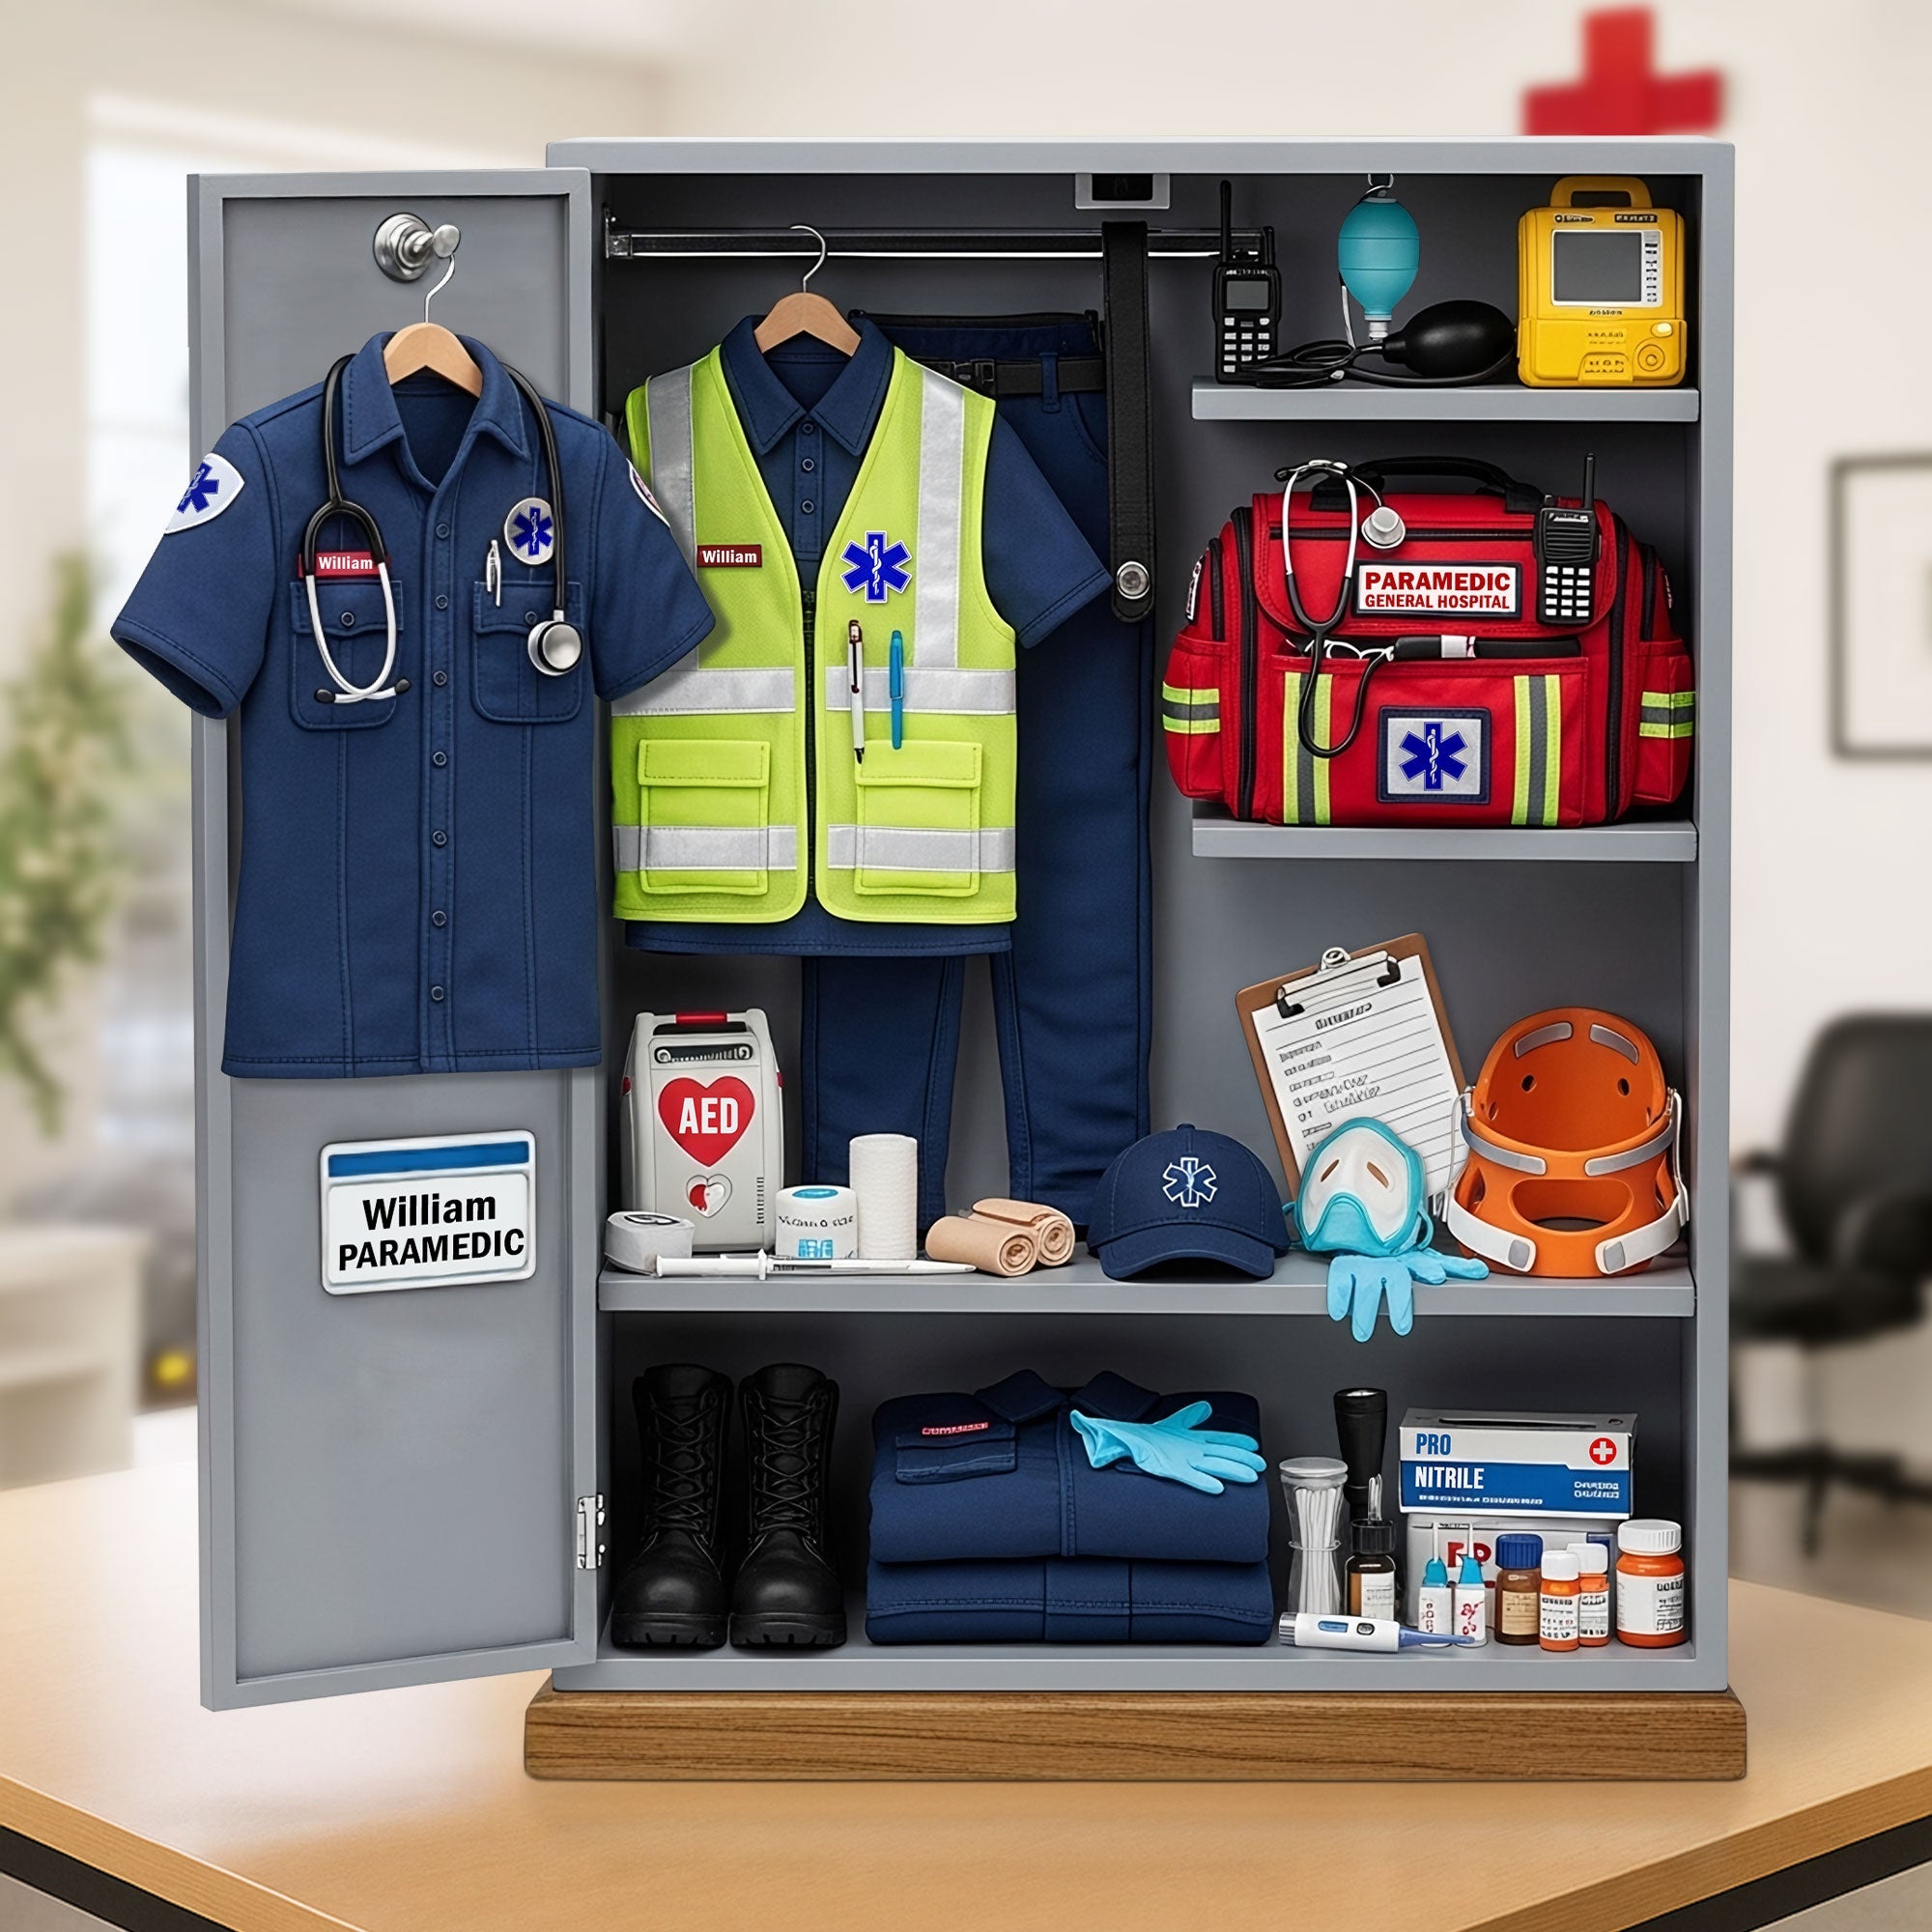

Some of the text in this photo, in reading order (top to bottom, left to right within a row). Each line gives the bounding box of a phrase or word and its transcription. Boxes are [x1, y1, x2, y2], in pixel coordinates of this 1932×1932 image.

[319, 556, 373, 570] William
[702, 550, 757, 563] William
[1365, 572, 1511, 592] PARAMEDIC
[1365, 594, 1511, 609] GENERAL HOSPITAL
[679, 1097, 739, 1134] AED
[362, 1193, 497, 1230] William
[338, 1229, 526, 1270] PARAMEDIC
[1416, 1434, 1451, 1456] PRO
[1415, 1466, 1485, 1490] NITRILE
